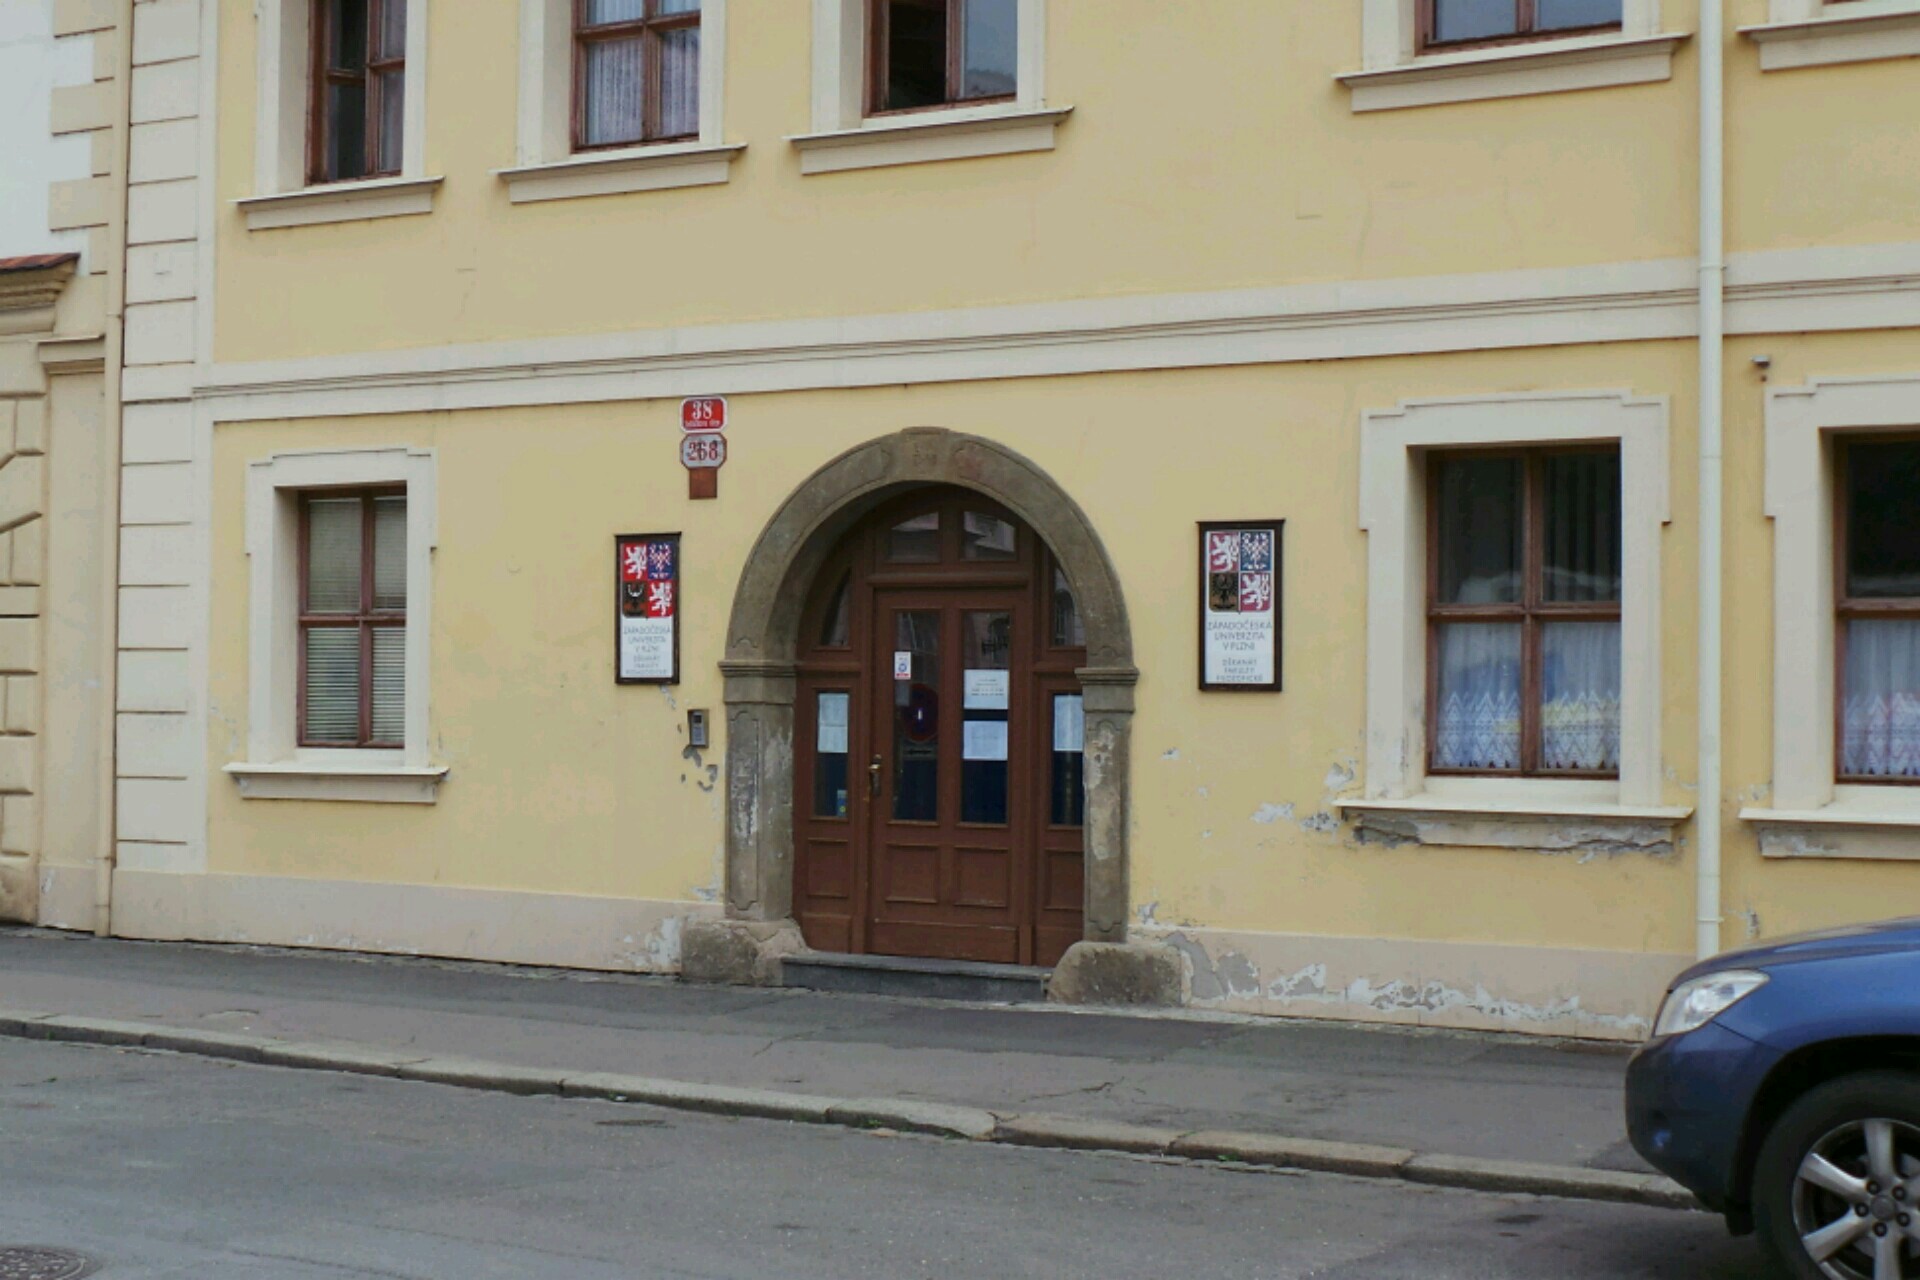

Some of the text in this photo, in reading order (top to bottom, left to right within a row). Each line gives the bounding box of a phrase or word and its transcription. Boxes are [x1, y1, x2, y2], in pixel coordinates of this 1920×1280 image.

[692, 400, 713, 420] 38
[687, 441, 718, 461] 268
[1214, 631, 1265, 641] UNIVERZITA
